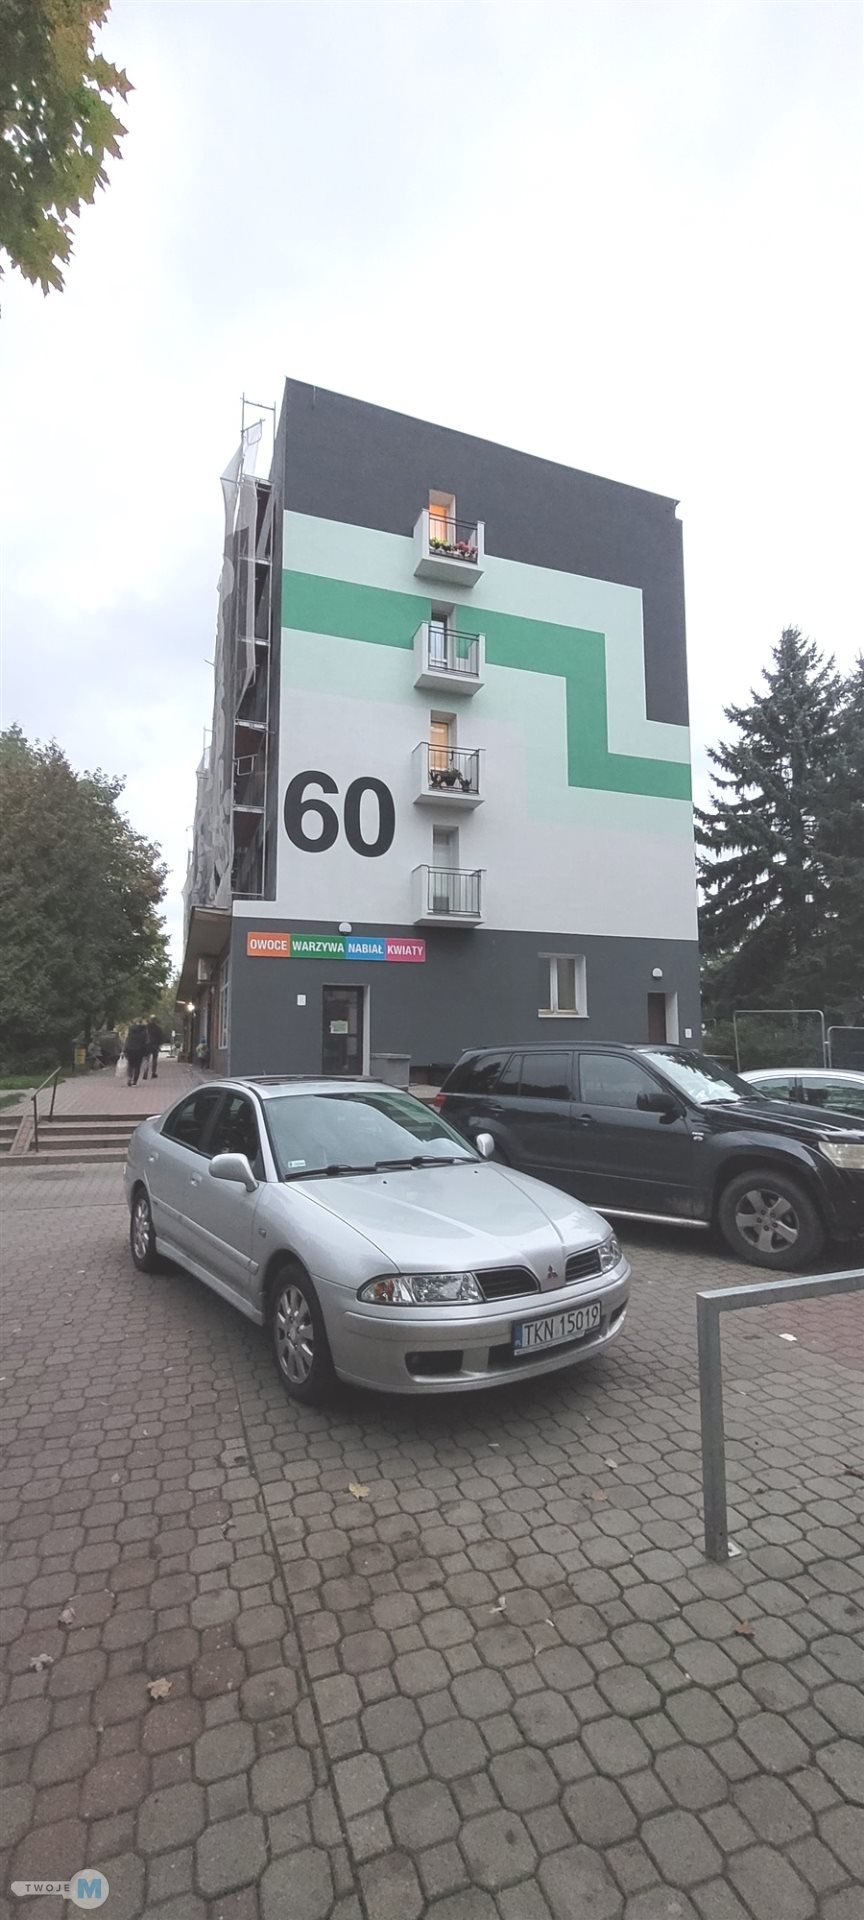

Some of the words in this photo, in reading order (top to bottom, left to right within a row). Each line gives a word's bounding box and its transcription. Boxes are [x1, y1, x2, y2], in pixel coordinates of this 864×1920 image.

[283, 770, 396, 858] 60
[250, 938, 287, 950] OWOCE
[292, 940, 344, 952] WARZYWA
[348, 943, 384, 955] NABIAŁ
[387, 944, 423, 956] KWIATY
[524, 1318, 554, 1345] TKN
[560, 1305, 599, 1335] 15019
